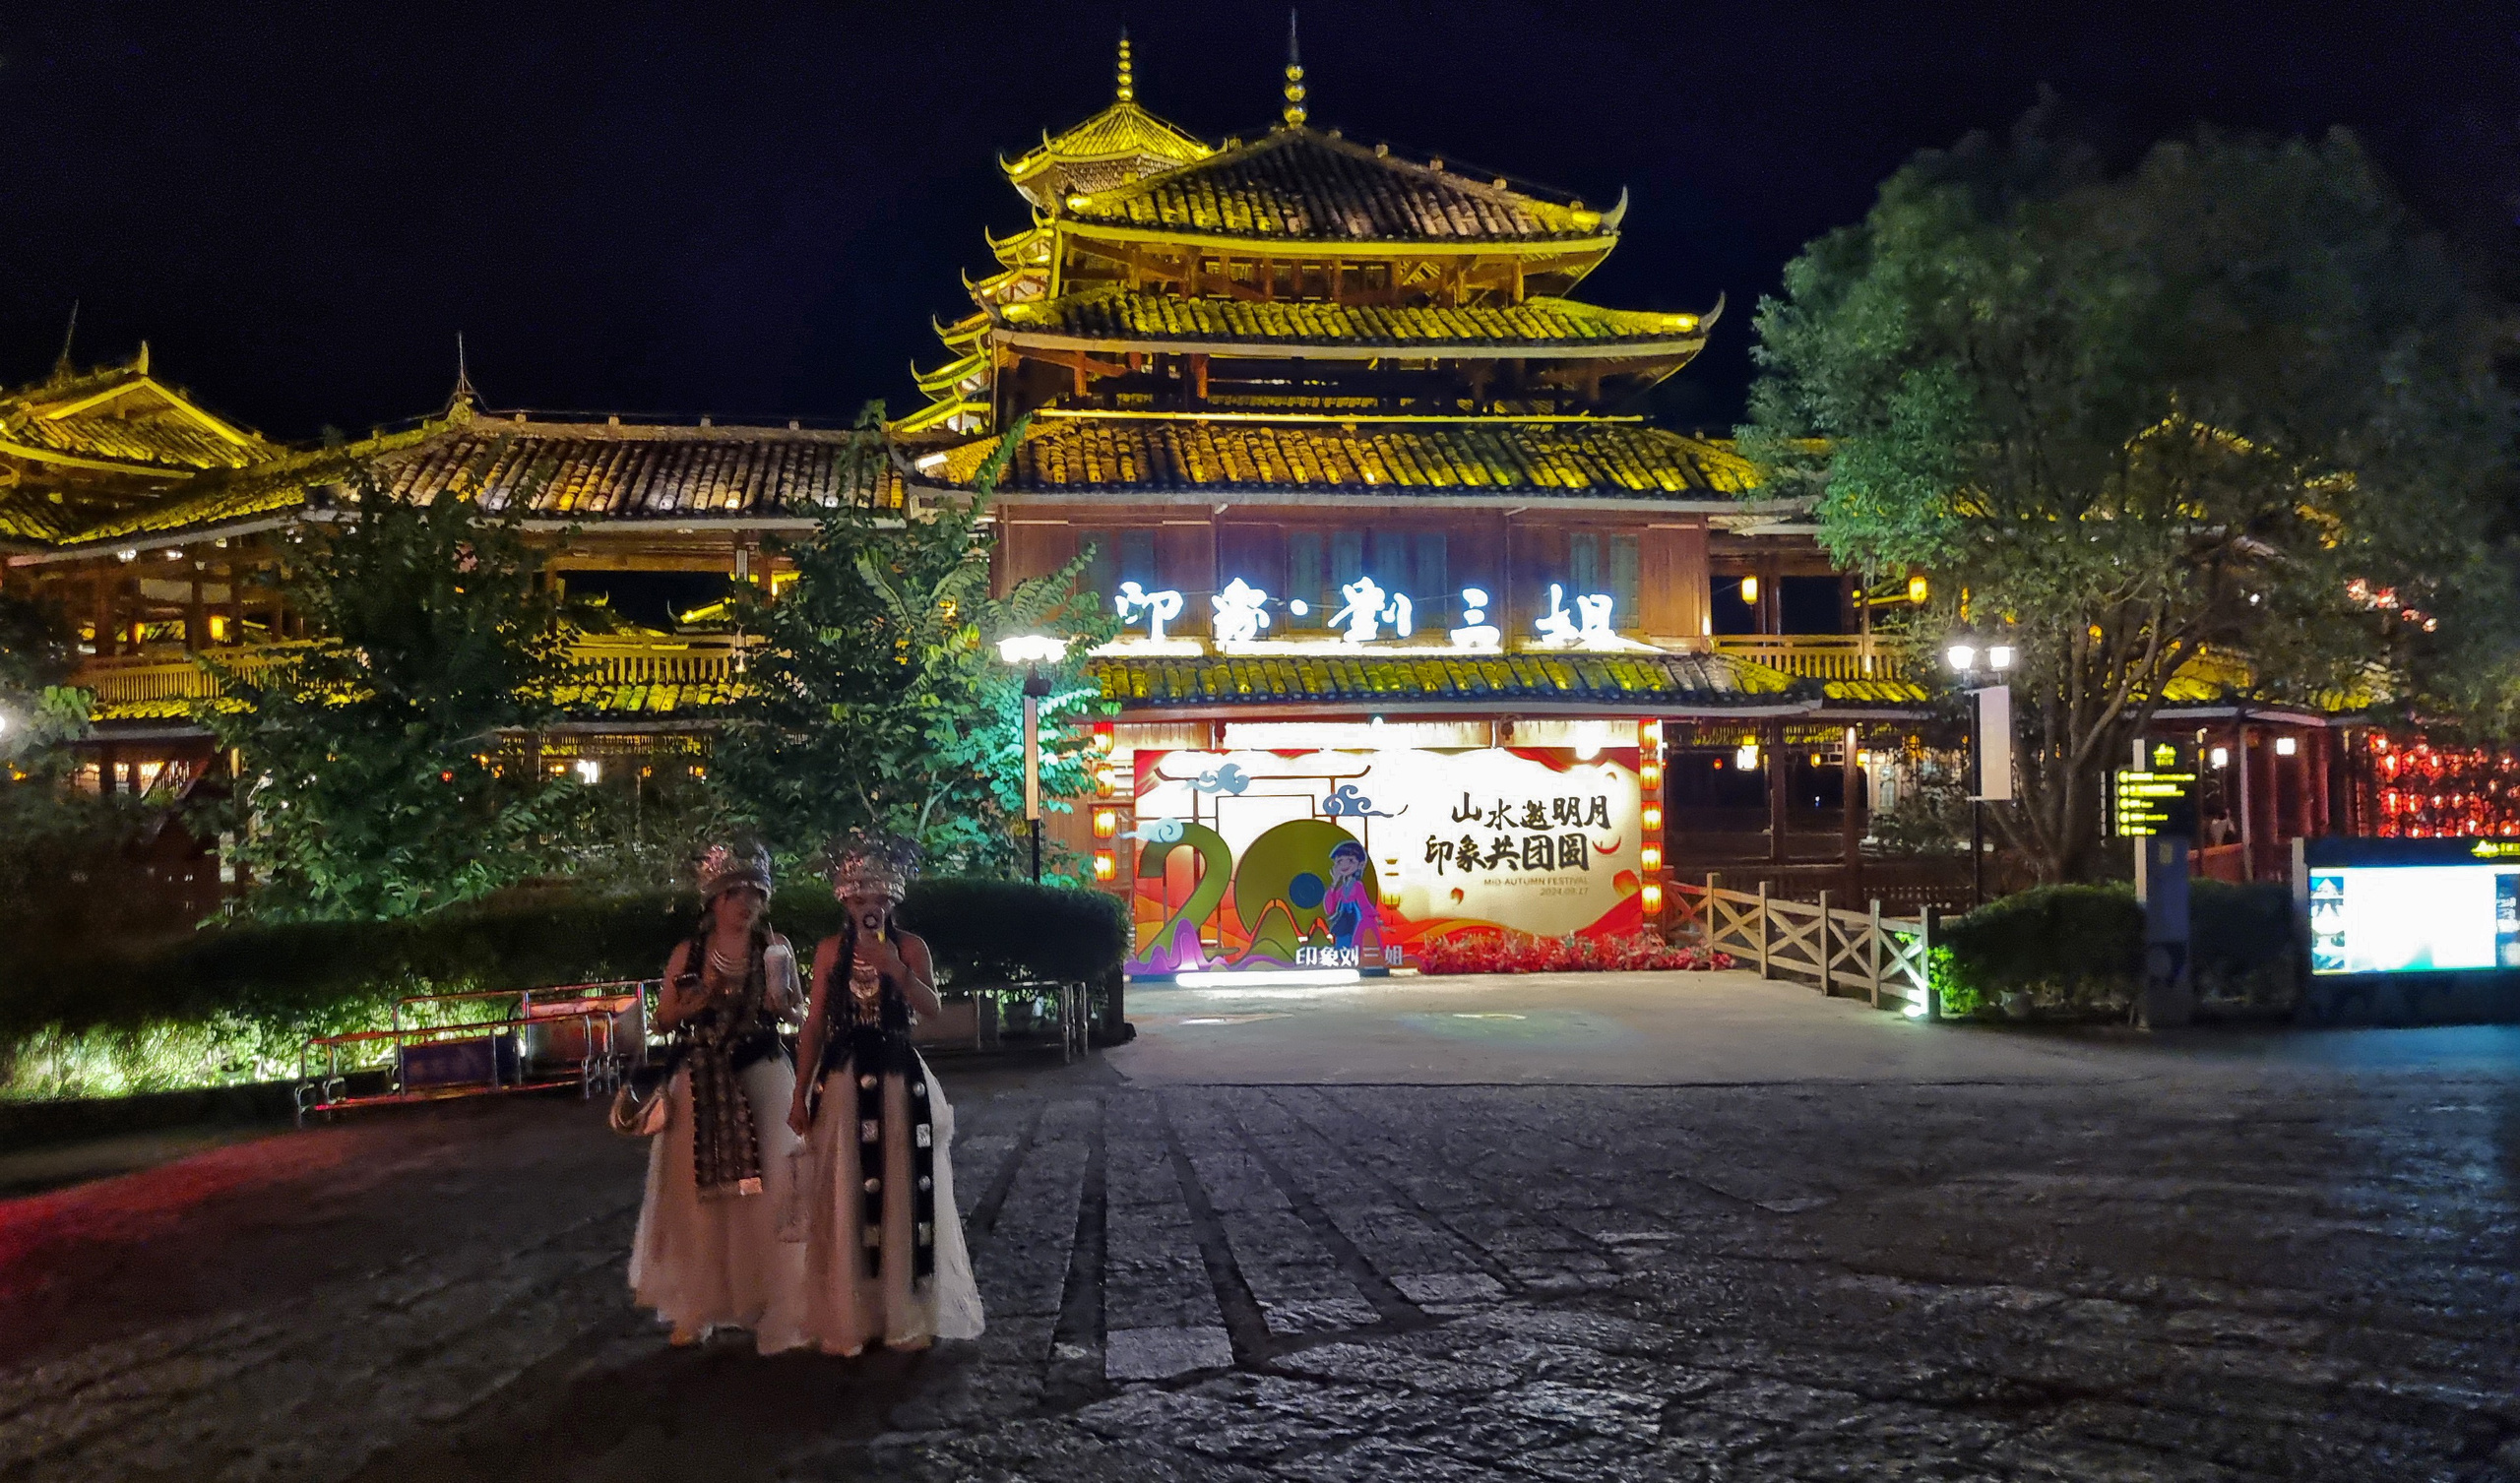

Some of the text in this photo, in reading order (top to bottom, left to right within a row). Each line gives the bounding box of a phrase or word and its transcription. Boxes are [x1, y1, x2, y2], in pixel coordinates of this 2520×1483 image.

[1451, 791, 1611, 831] 山水邀明月
[1424, 833, 1590, 876] 印象共团圆
